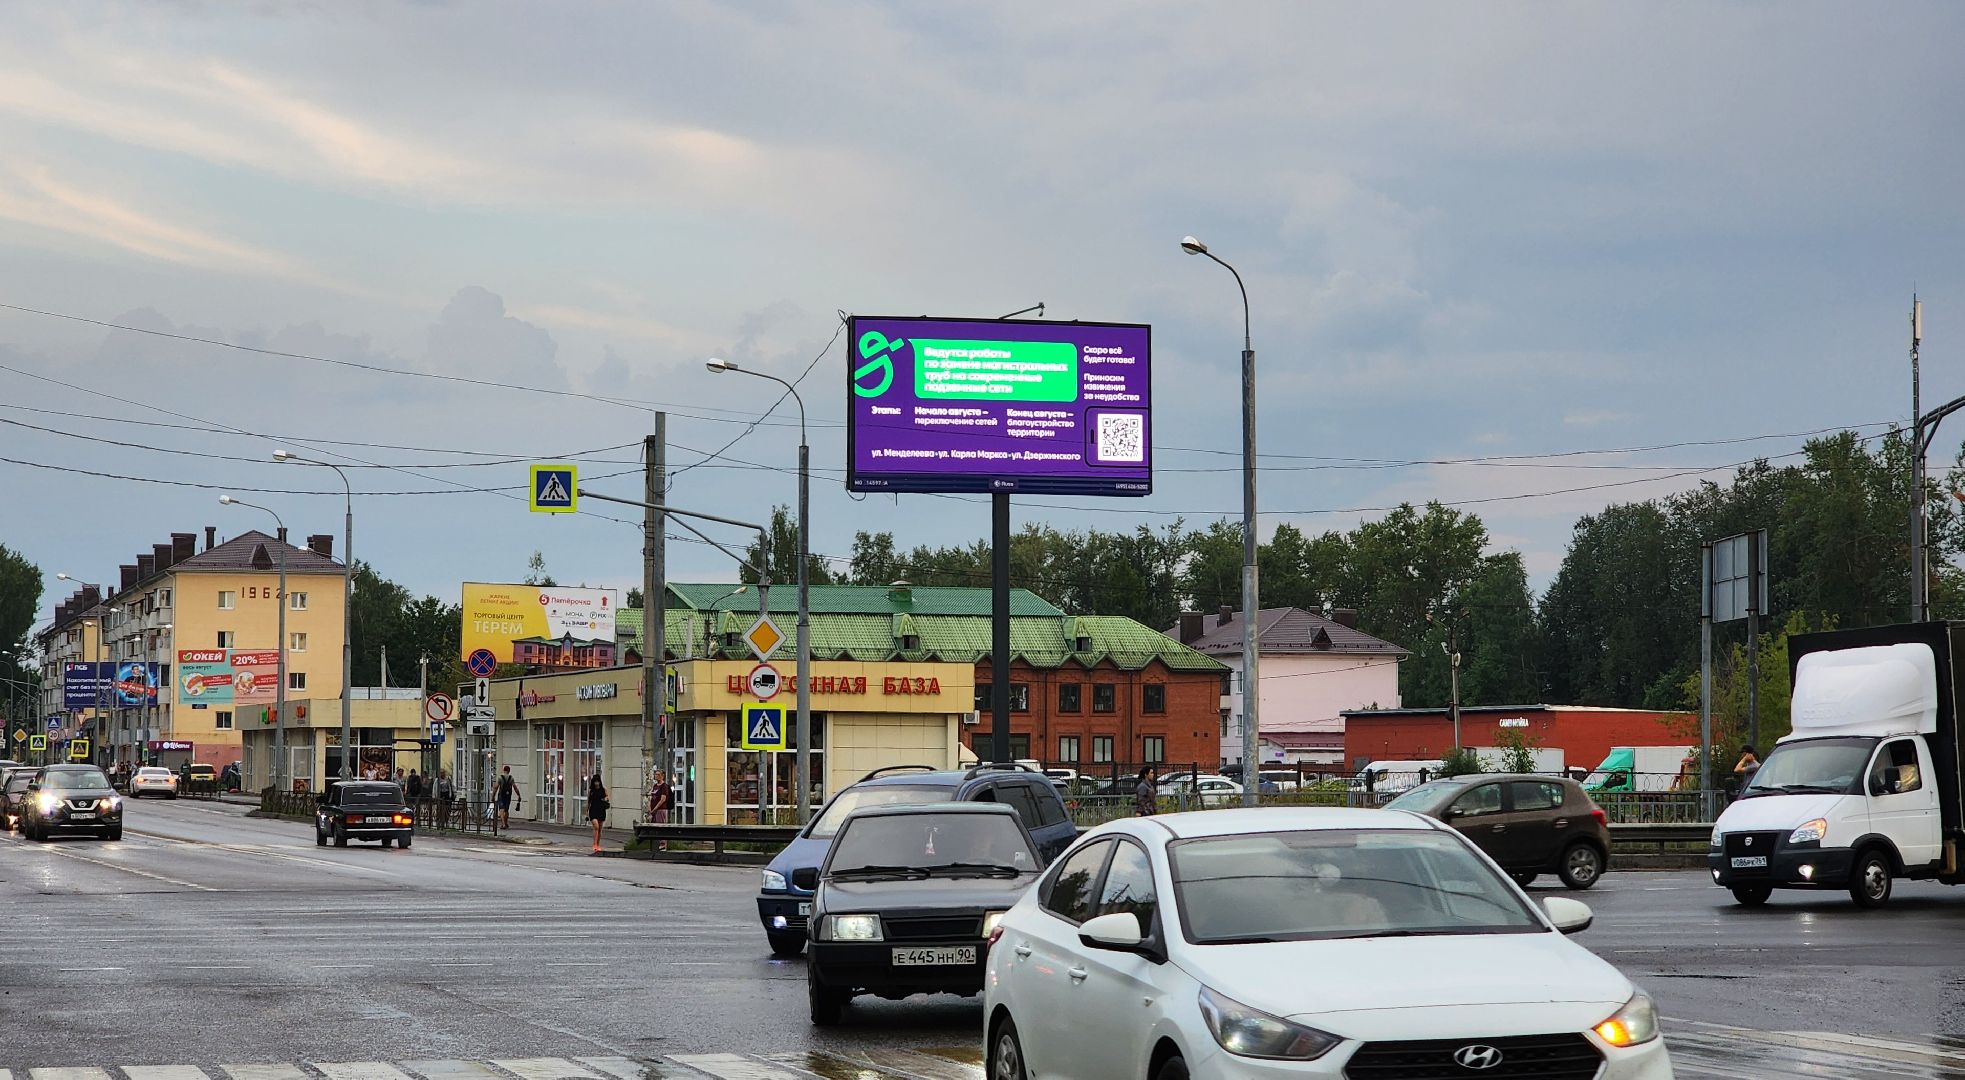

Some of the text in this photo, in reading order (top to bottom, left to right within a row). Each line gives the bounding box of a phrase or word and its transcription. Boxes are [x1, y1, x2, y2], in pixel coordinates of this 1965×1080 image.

[969, 348, 1012, 361] работы
[1083, 345, 1123, 355] Скоро всё
[1083, 355, 1135, 364] будет готово!
[924, 360, 939, 368] по
[981, 361, 1068, 374] магистральных
[924, 371, 950, 383] труб
[951, 373, 967, 381] на
[1083, 373, 1125, 383] Приносим
[987, 385, 1014, 395] сети
[1083, 383, 1126, 392] извинения
[871, 405, 902, 415] Этапы:
[914, 406, 948, 416] Начало
[948, 408, 982, 417] августа
[1006, 408, 1034, 418] Конец
[1034, 410, 1067, 419] августа
[914, 417, 998, 426] переключение сетей
[1006, 418, 1075, 429] благоустройство
[1006, 428, 1056, 438] территории
[871, 449, 883, 458] ул.
[951, 449, 977, 460] Карла
[1023, 450, 1081, 461] Дзержинского
[474, 620, 523, 635] ТЕРЕМ
[232, 656, 258, 665] -20%
[883, 677, 941, 695] БАЗА
